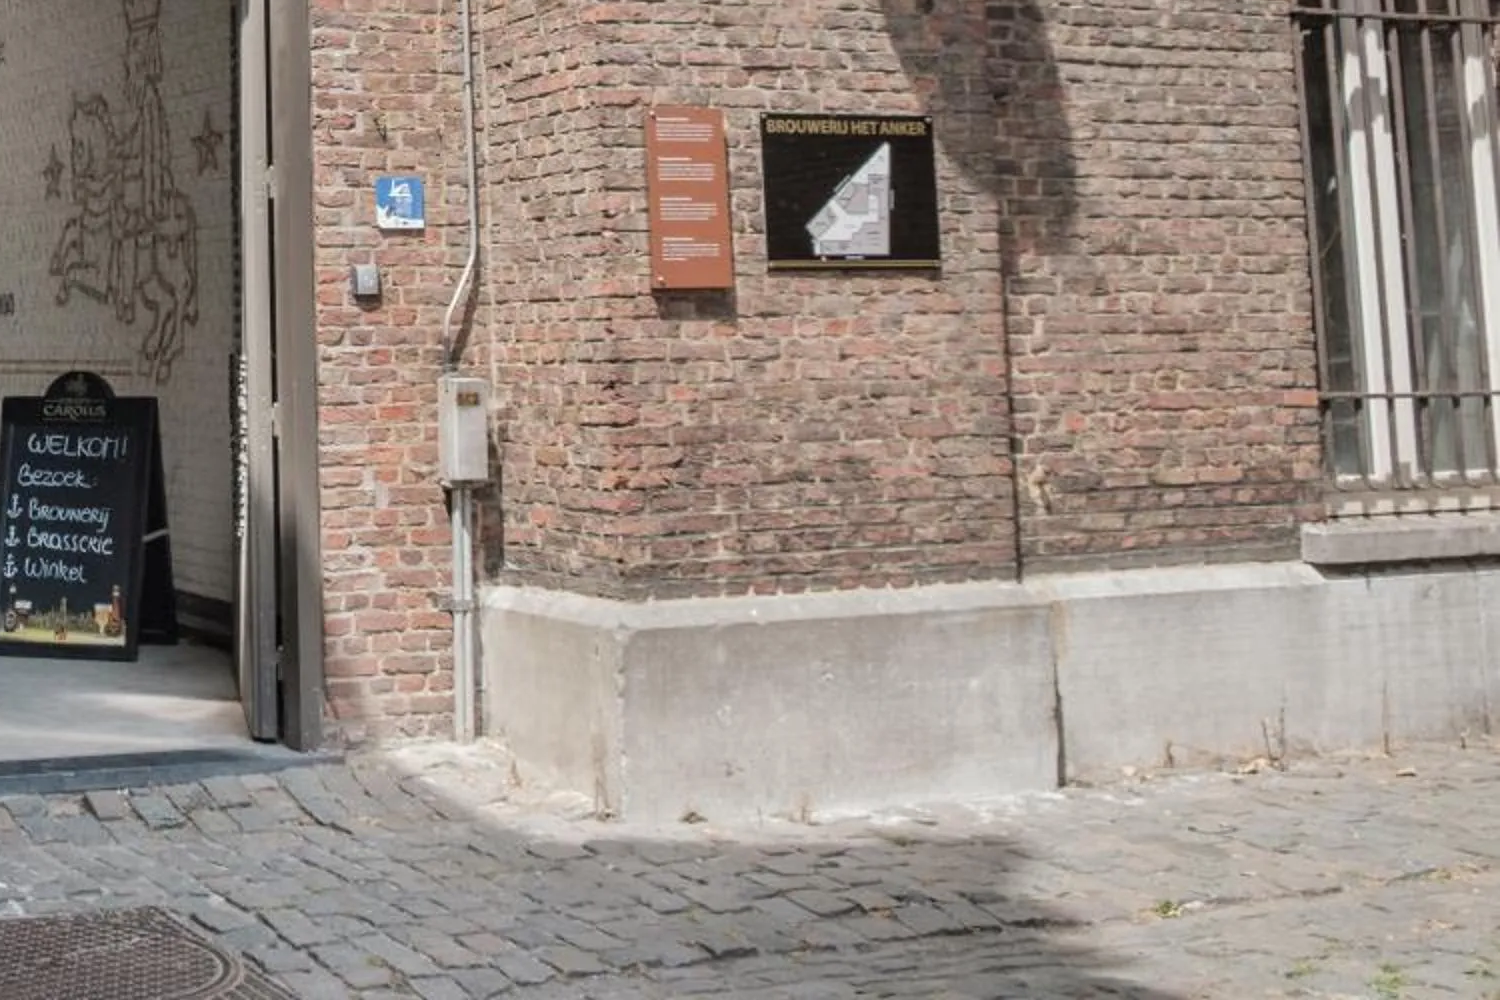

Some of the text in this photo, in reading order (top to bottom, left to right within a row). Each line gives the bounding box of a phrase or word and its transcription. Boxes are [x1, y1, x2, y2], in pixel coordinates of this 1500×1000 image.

[765, 118, 926, 137] BROUWERIJ HET ANKER
[27, 432, 129, 463] WELKOM!
[24, 557, 88, 583] Winkel
